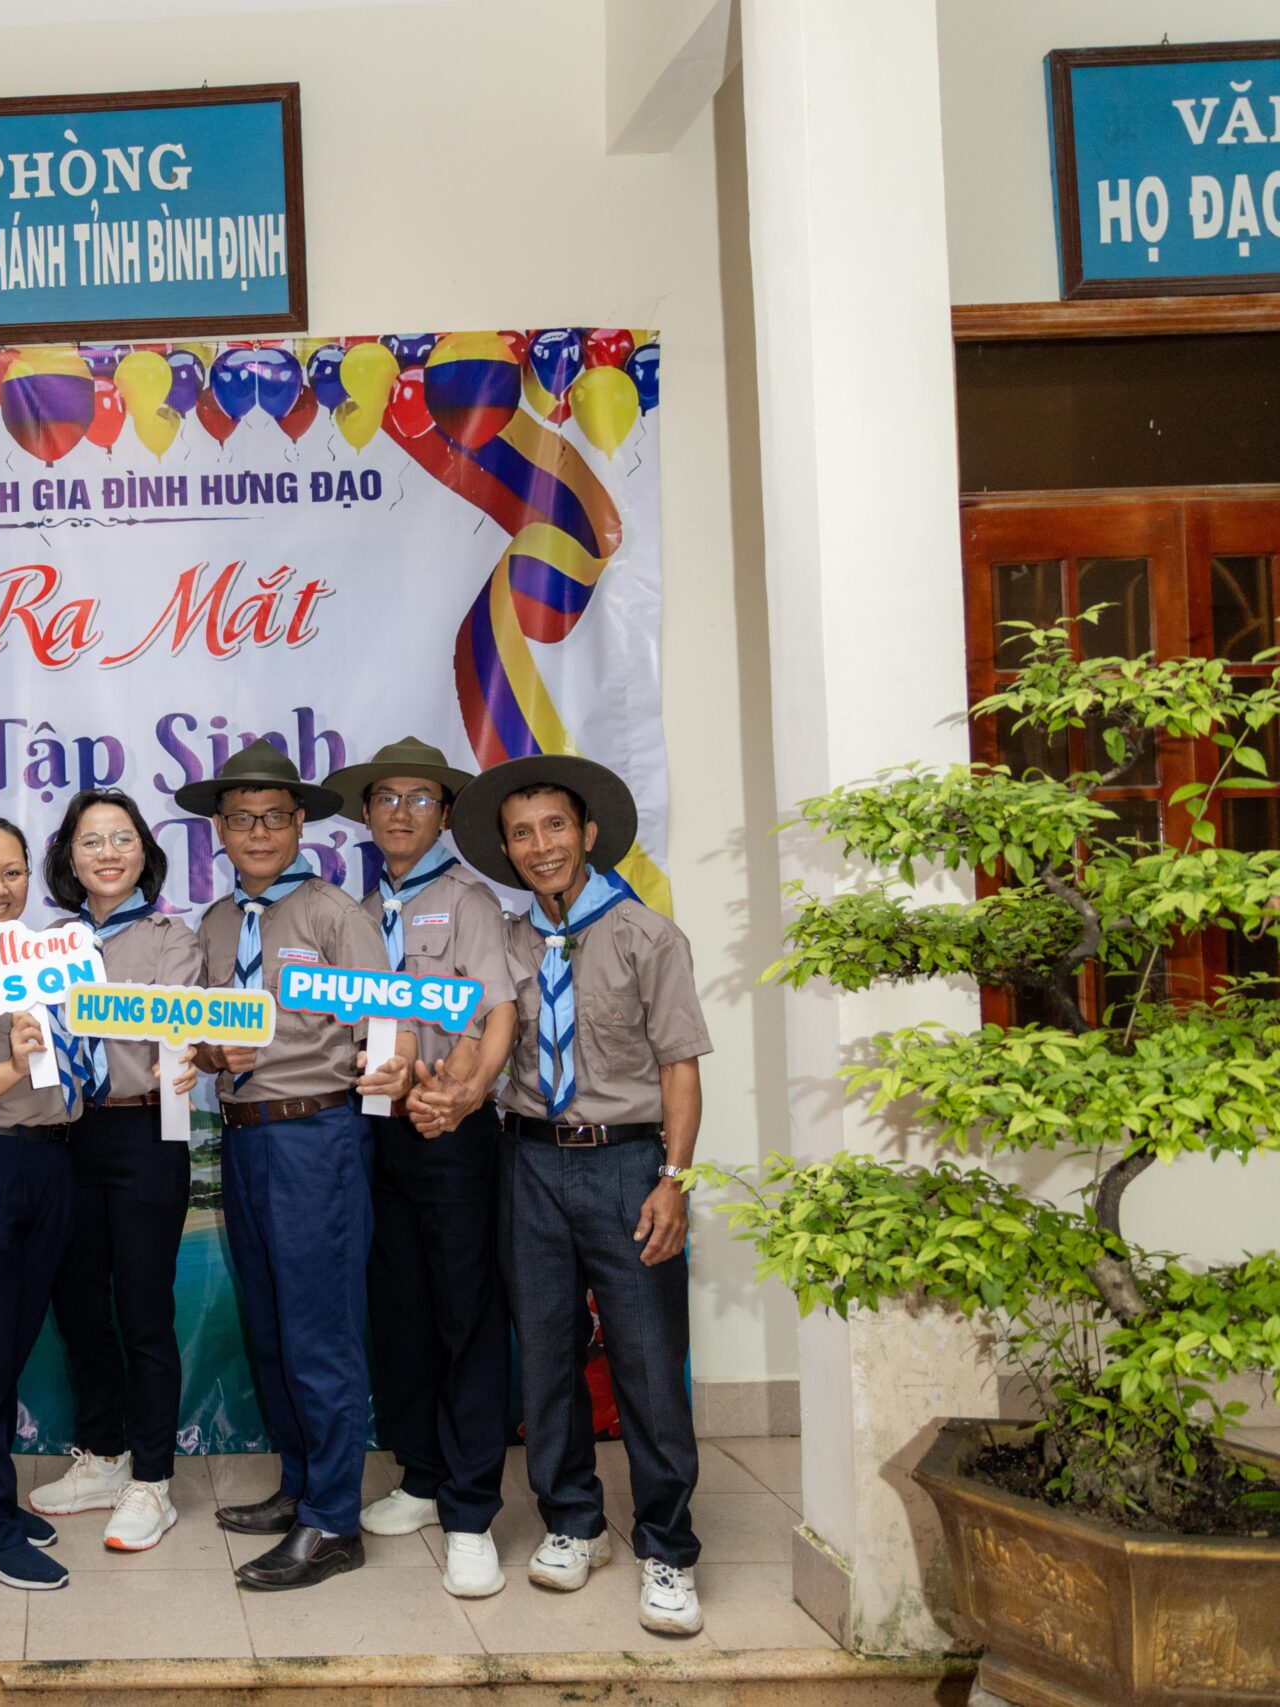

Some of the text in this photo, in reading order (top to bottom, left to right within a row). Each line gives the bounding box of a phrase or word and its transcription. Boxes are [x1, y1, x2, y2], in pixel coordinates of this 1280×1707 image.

[1172, 79, 1280, 145] VĂ
[73, 198, 141, 287] TỈNH
[147, 202, 214, 283] BÌNH
[218, 213, 287, 291] ĐỊNH
[1097, 175, 1169, 263] HỌ
[32, 478, 92, 511] GIA
[101, 470, 188, 509] ĐÌNH
[200, 469, 299, 506] HƯNG
[309, 468, 382, 509] ĐẠO
[98, 559, 334, 667] Mắt
[37, 959, 96, 995] QN
[288, 971, 475, 1021] PHỤNG SỰ
[77, 993, 264, 1034] HƯNG ĐẠO SINH
